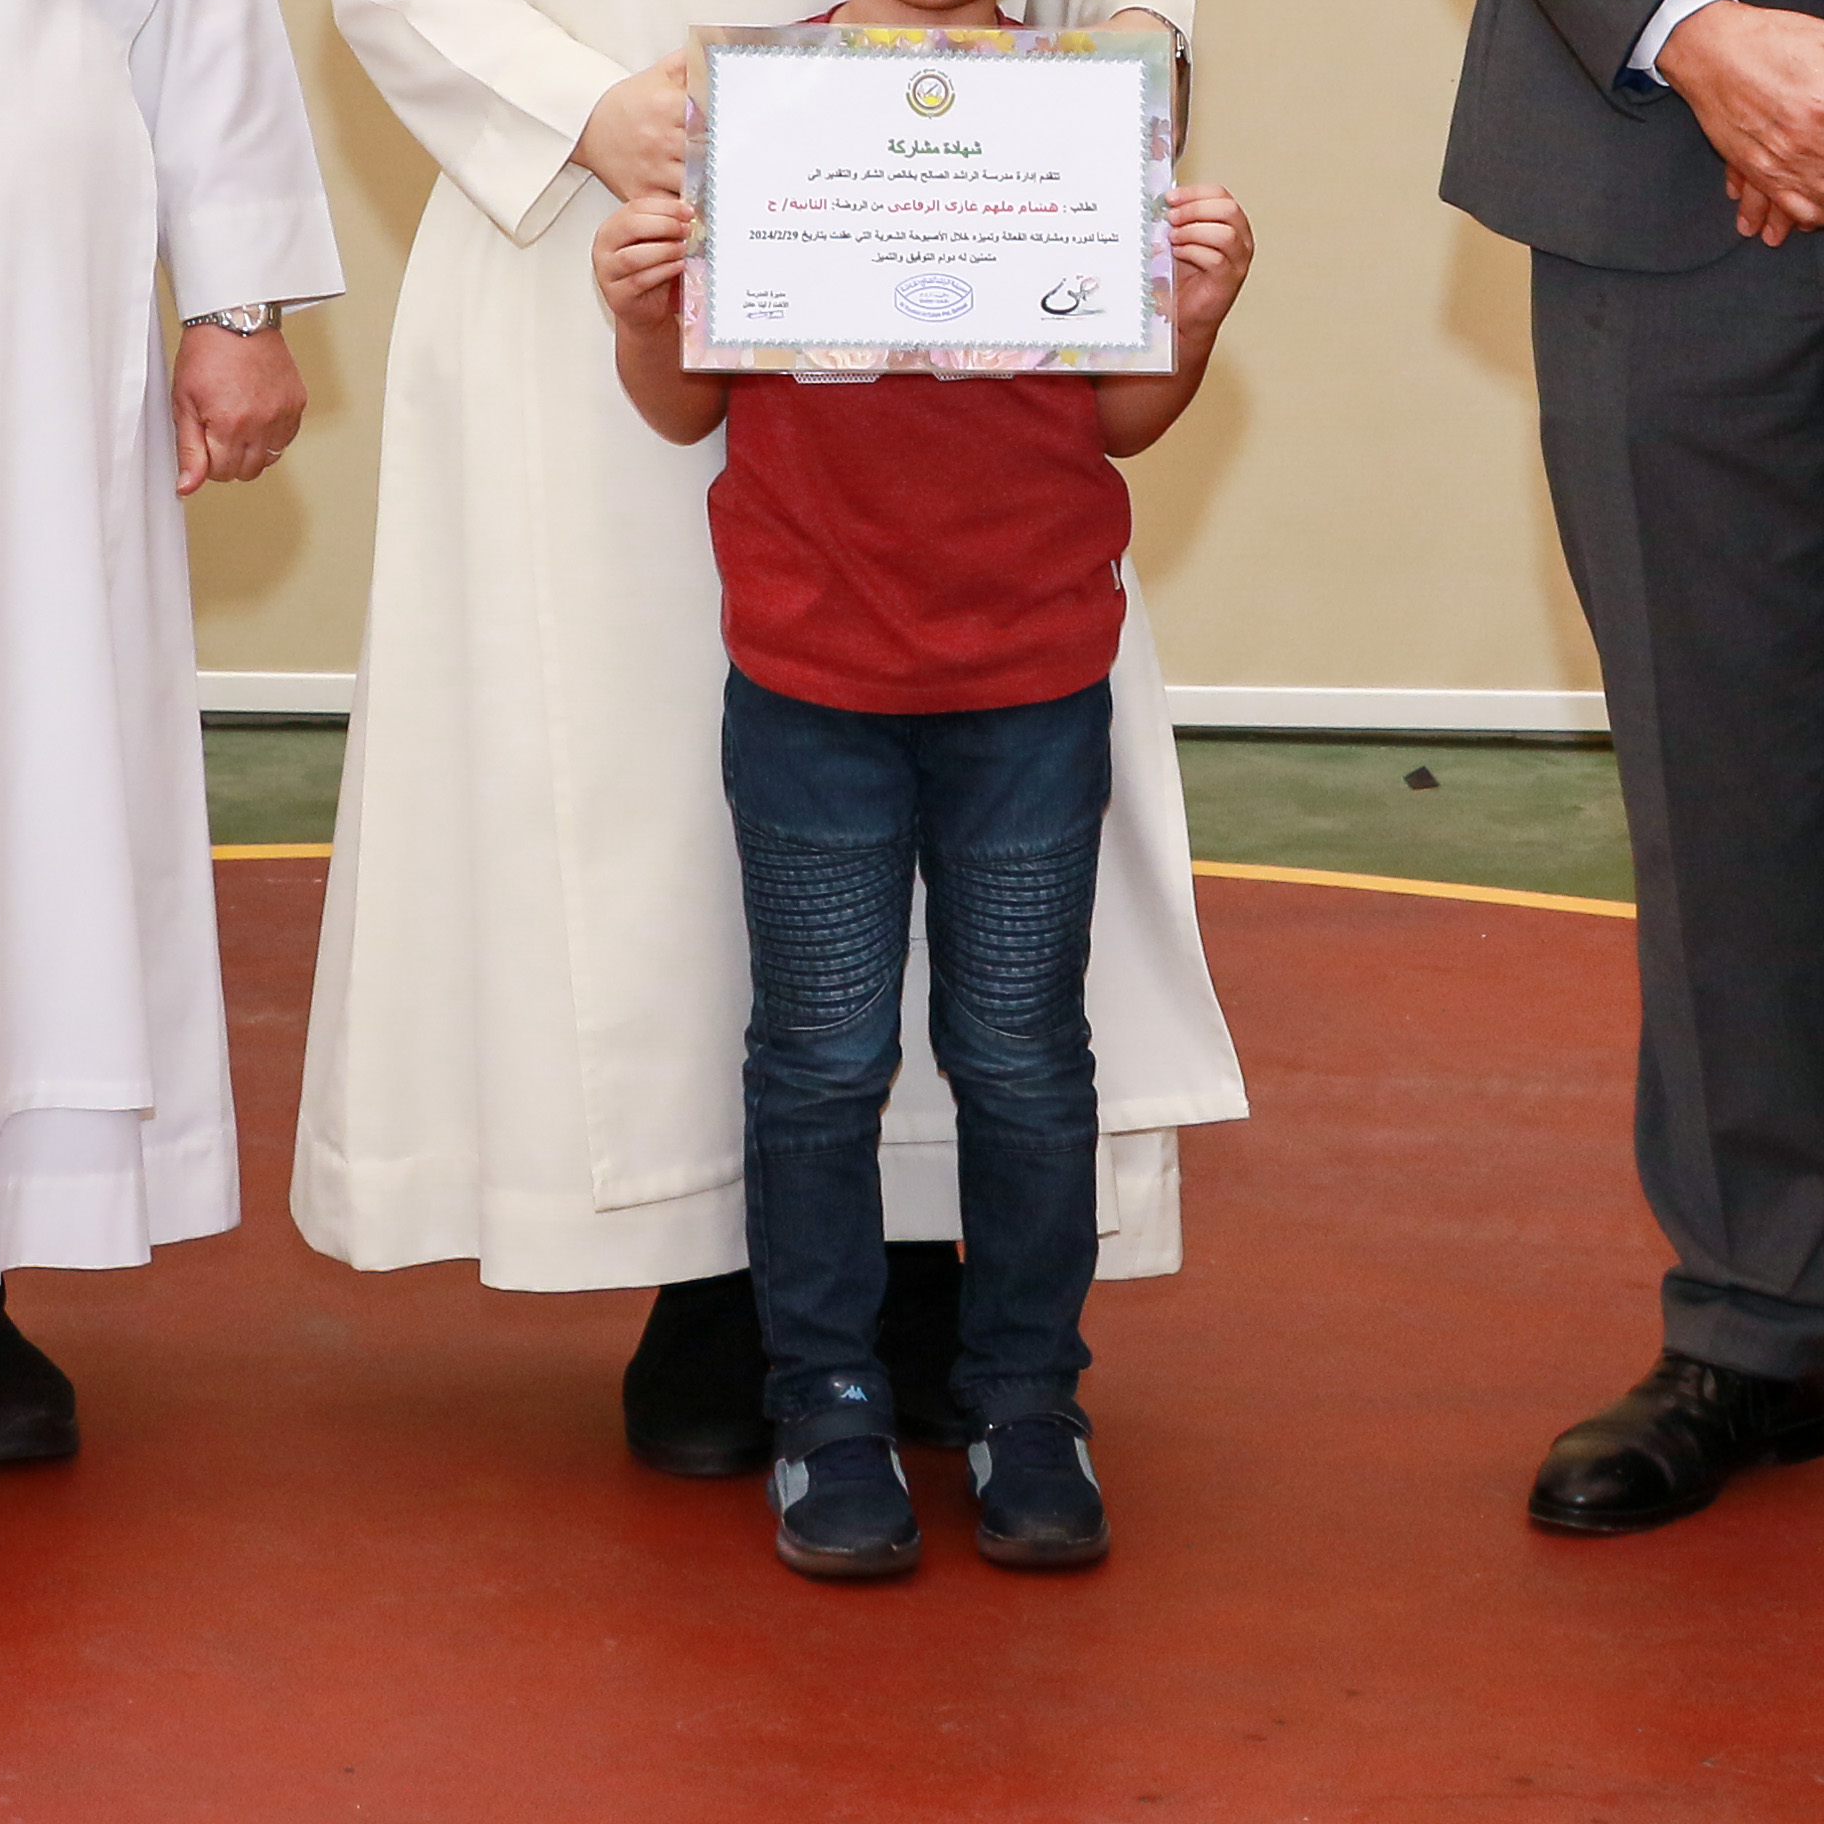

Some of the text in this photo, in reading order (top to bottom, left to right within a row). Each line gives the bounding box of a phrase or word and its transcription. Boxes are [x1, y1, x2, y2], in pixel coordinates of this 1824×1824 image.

[887, 138, 982, 158] شهادة مشاركة
[824, 168, 858, 181] والتقدير
[861, 168, 885, 181] الشكر
[887, 169, 918, 182] بخالص
[920, 169, 950, 183] الصالح
[952, 169, 979, 182] الراشد
[982, 169, 1014, 182] مدرسة
[1039, 171, 1061, 183] تتقدم
[870, 200, 884, 212] من
[1070, 201, 1098, 214] الطالب
[749, 230, 799, 240] 2024/2/29
[801, 229, 828, 242] بتاريخ
[874, 229, 906, 242] الشعرية
[950, 231, 970, 242] خلال
[1029, 232, 1069, 243] ومشاركته
[1071, 232, 1095, 244] لدوره
[905, 250, 936, 264] التوفيق
[937, 253, 955, 264] دوام
[957, 252, 967, 262] له
